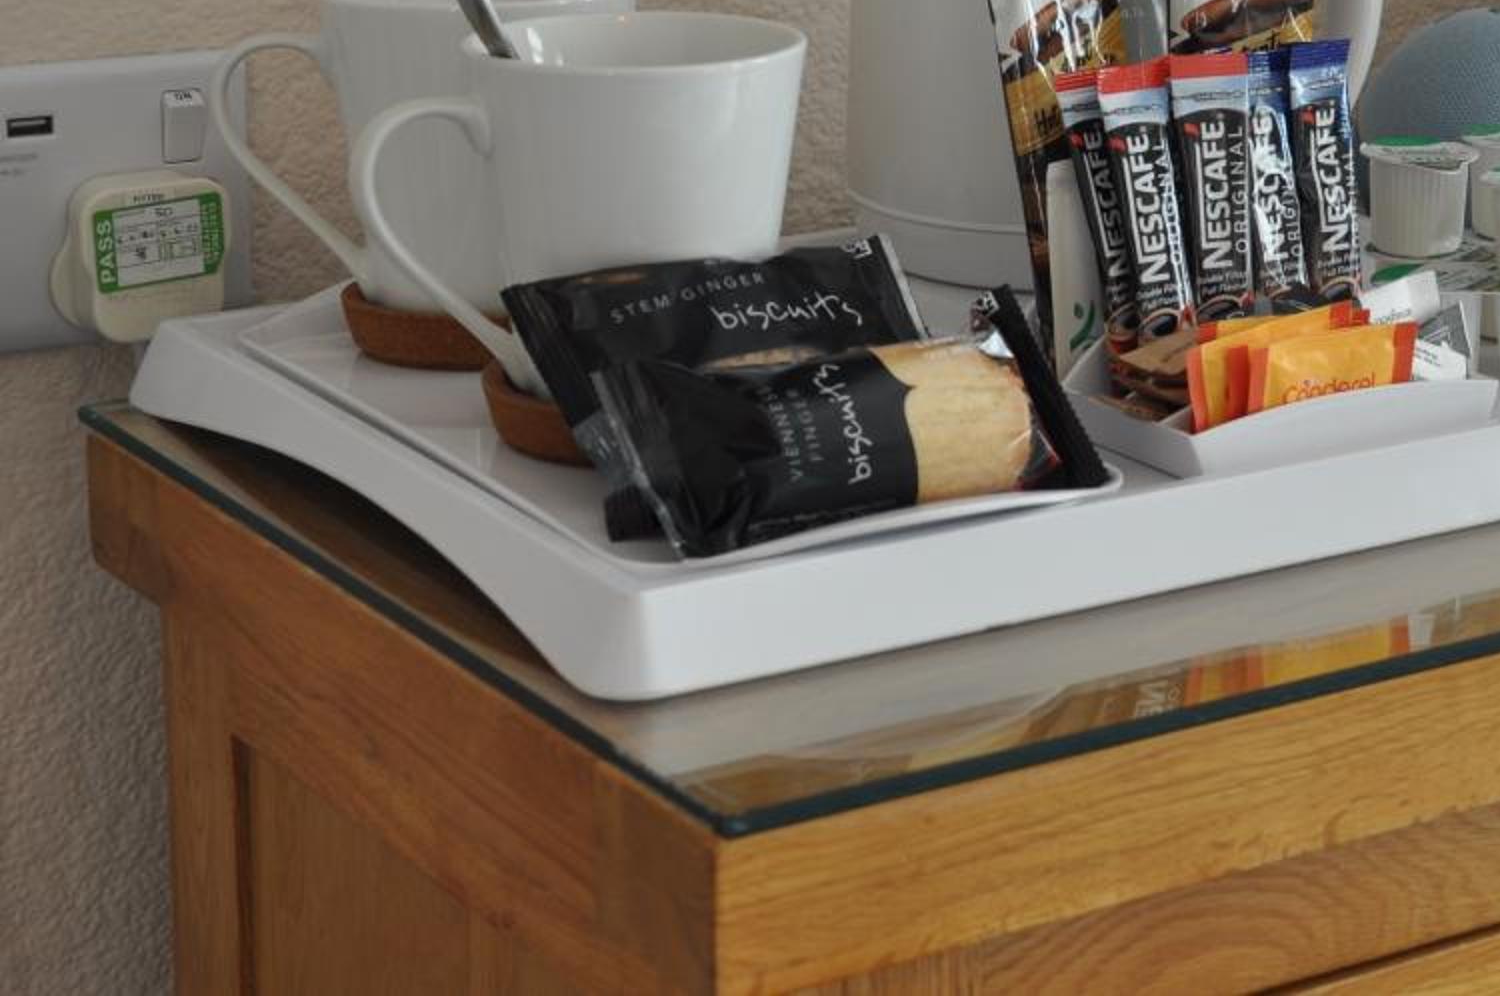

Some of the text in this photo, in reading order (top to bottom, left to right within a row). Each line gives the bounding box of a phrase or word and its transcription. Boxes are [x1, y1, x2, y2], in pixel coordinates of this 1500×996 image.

[1228, 124, 1249, 254] ORIGINAL
[97, 220, 116, 283] PASS
[610, 270, 767, 325] STEM GINGER
[710, 290, 863, 331] biscuits
[812, 363, 874, 485] biscuits
